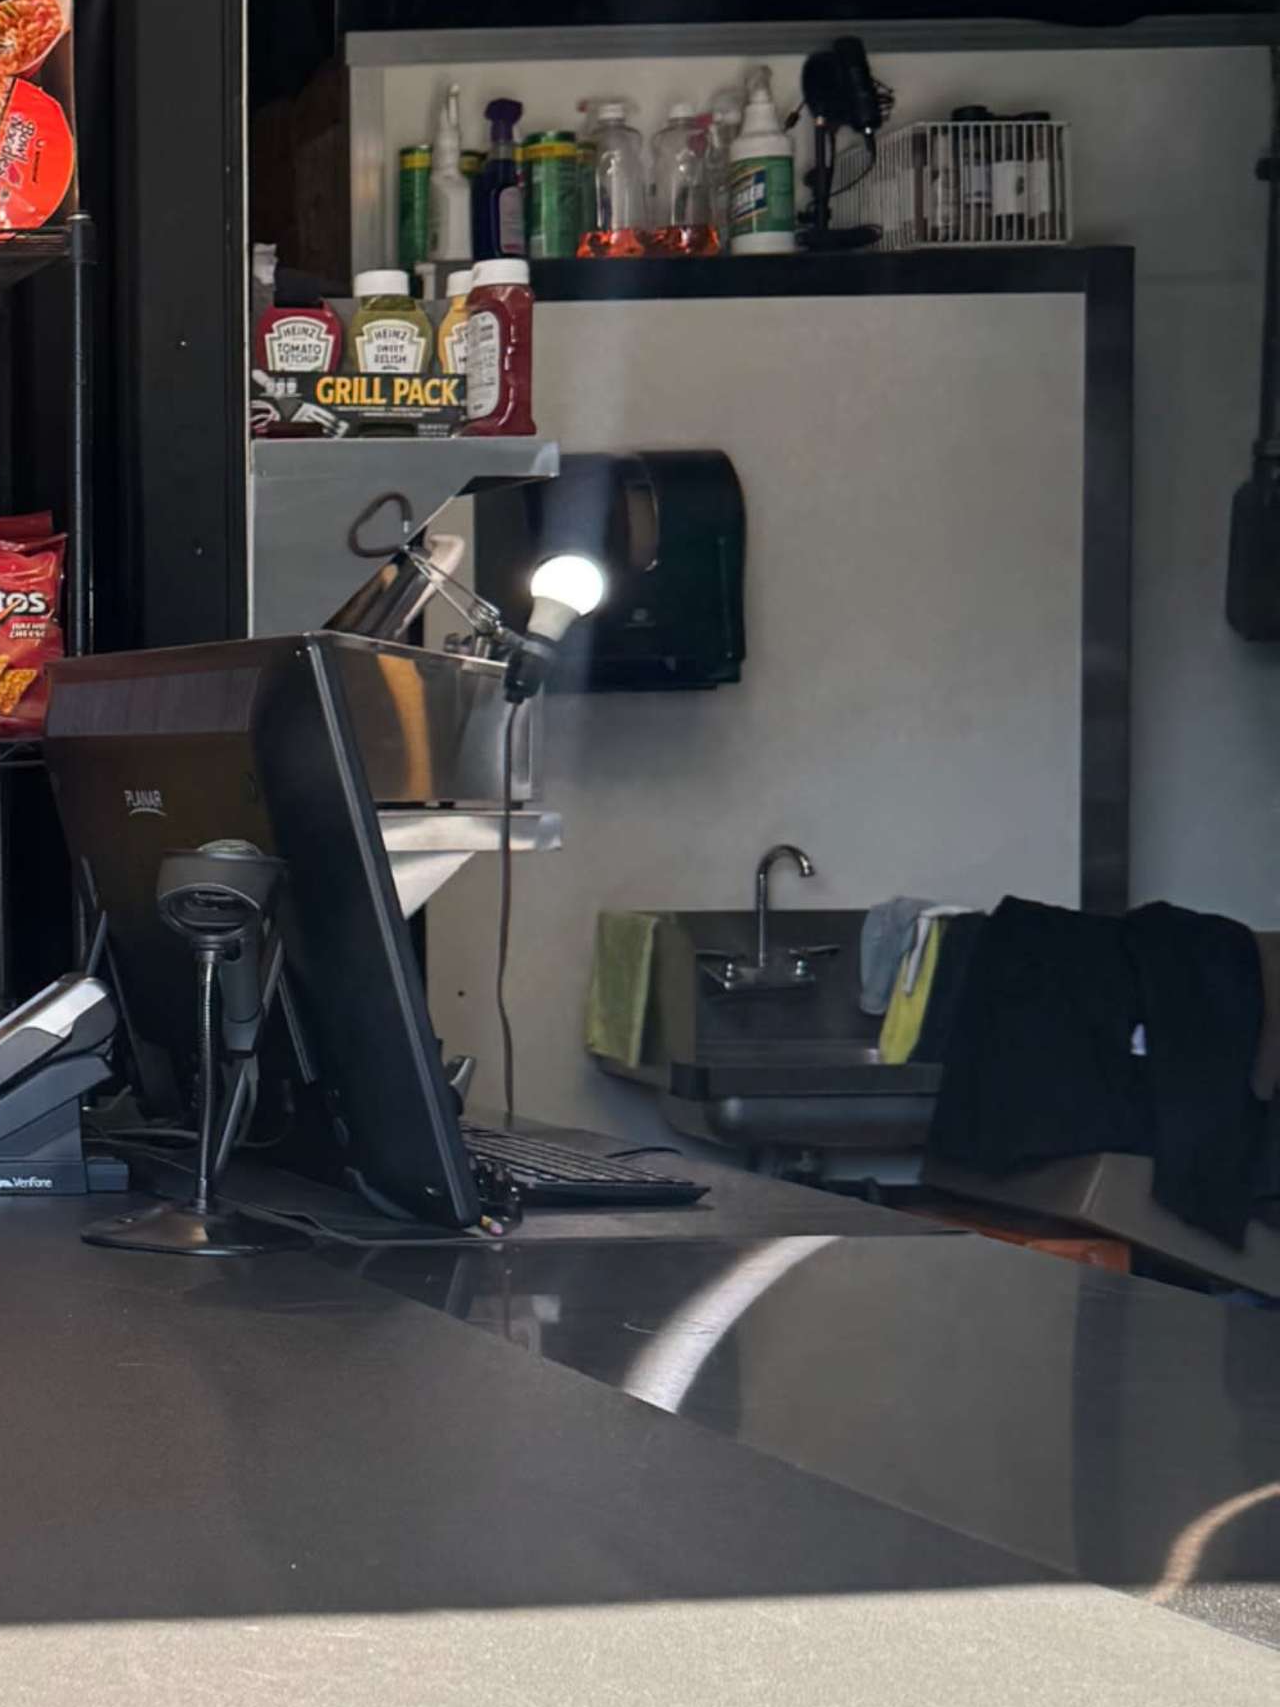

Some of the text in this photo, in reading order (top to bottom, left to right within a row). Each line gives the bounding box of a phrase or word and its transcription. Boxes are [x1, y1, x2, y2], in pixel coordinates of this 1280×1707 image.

[11, 120, 37, 164] Bowl
[282, 326, 317, 339] HEINZ
[374, 329, 408, 342] HEINZ
[277, 343, 322, 354] TOMATO
[315, 376, 460, 407] GRILL PACK
[124, 789, 163, 808] PLANAR
